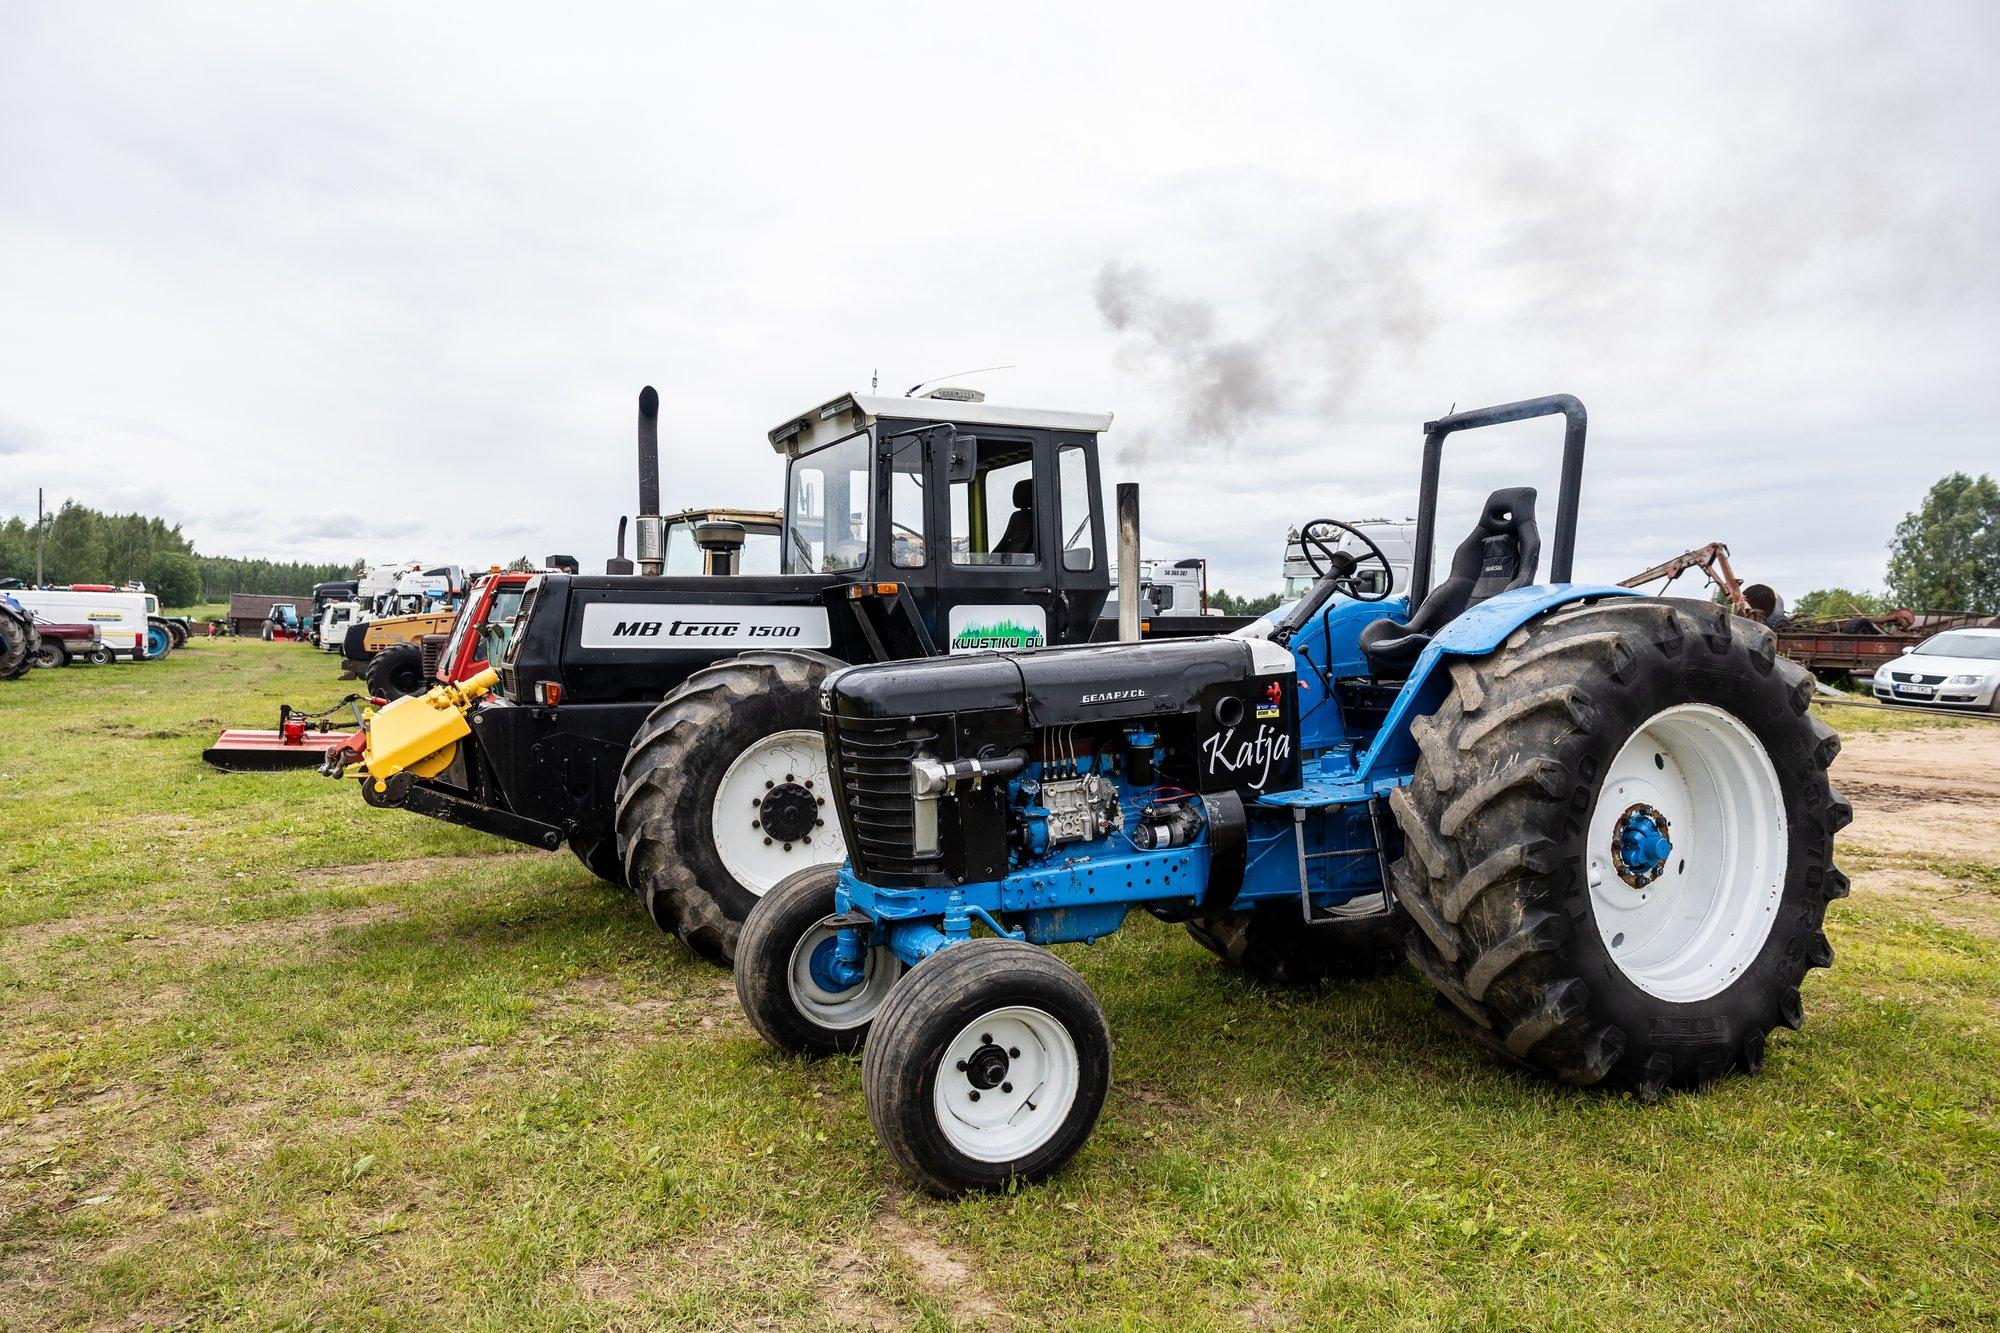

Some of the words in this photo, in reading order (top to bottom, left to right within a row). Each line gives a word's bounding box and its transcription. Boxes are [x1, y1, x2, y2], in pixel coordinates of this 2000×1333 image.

[612, 621, 662, 637] MB
[668, 620, 741, 637] trac
[748, 626, 801, 637] 1500
[952, 637, 1019, 649] KUUSTIKU
[1025, 635, 1044, 648] OÜ
[1082, 689, 1145, 703] БЕЛАРУСЬ
[1202, 724, 1290, 789] Katja
